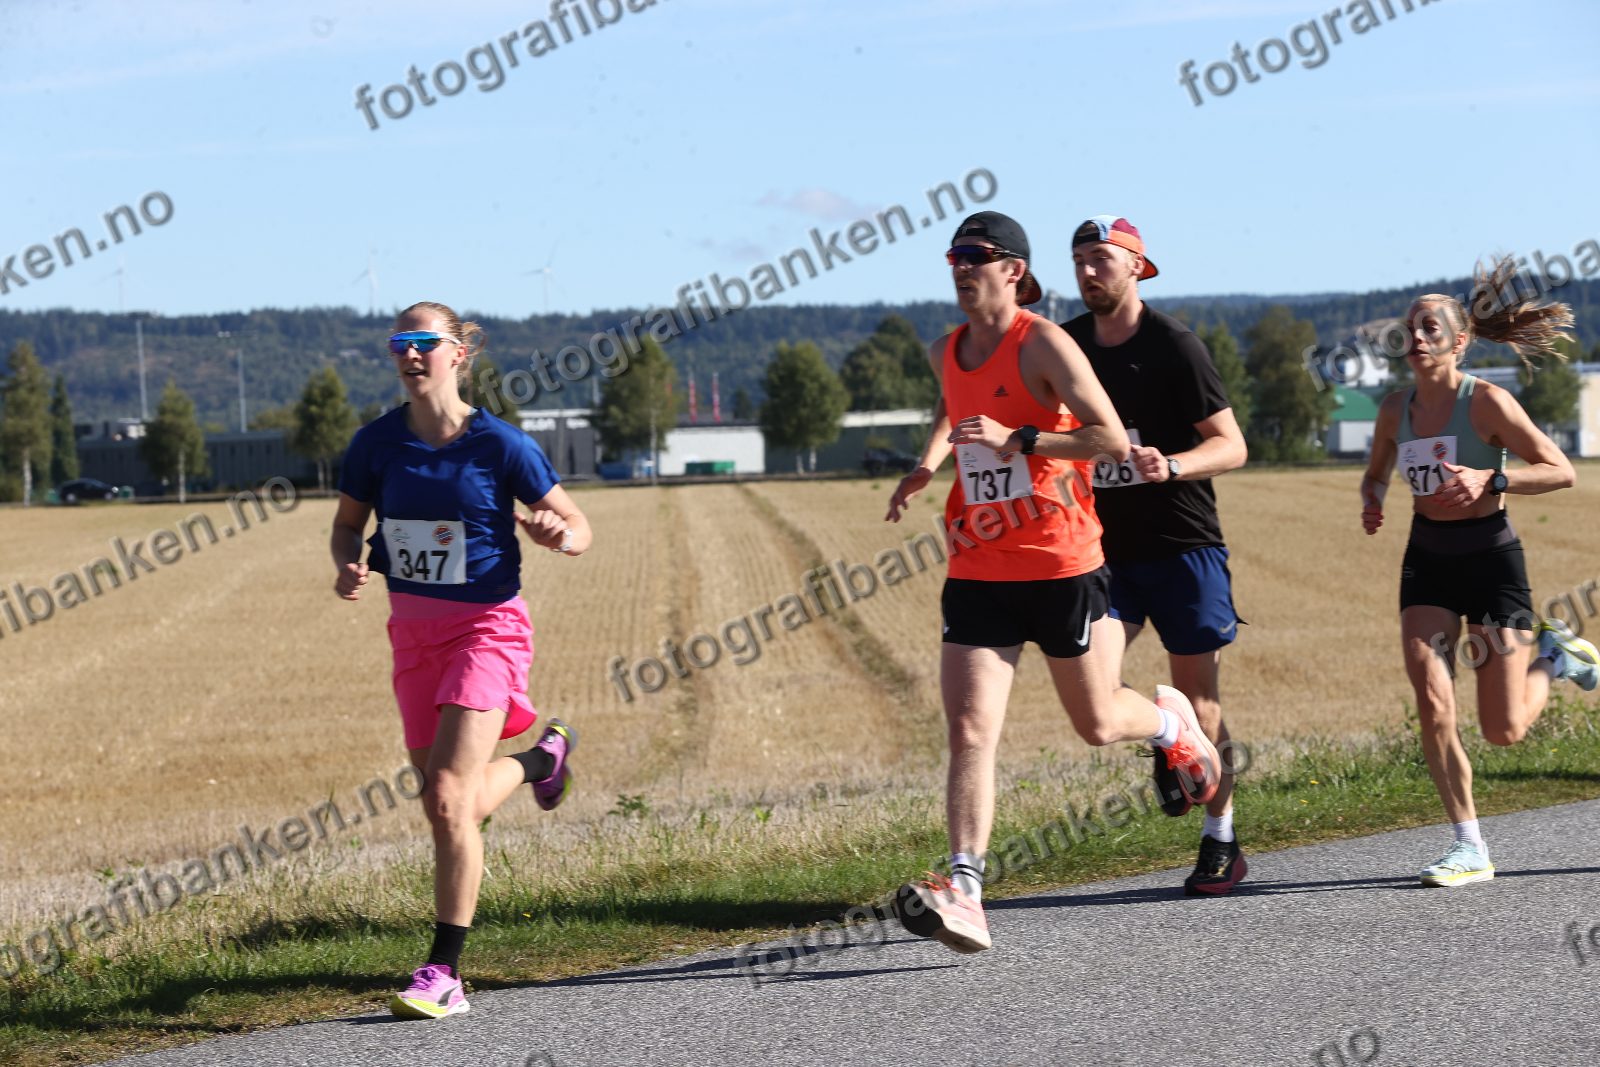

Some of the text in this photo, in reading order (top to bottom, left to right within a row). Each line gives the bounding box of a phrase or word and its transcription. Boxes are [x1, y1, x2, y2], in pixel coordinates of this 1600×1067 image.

[967, 466, 1012, 502] 737
[1407, 464, 1445, 493] 871
[398, 548, 449, 581] 347
